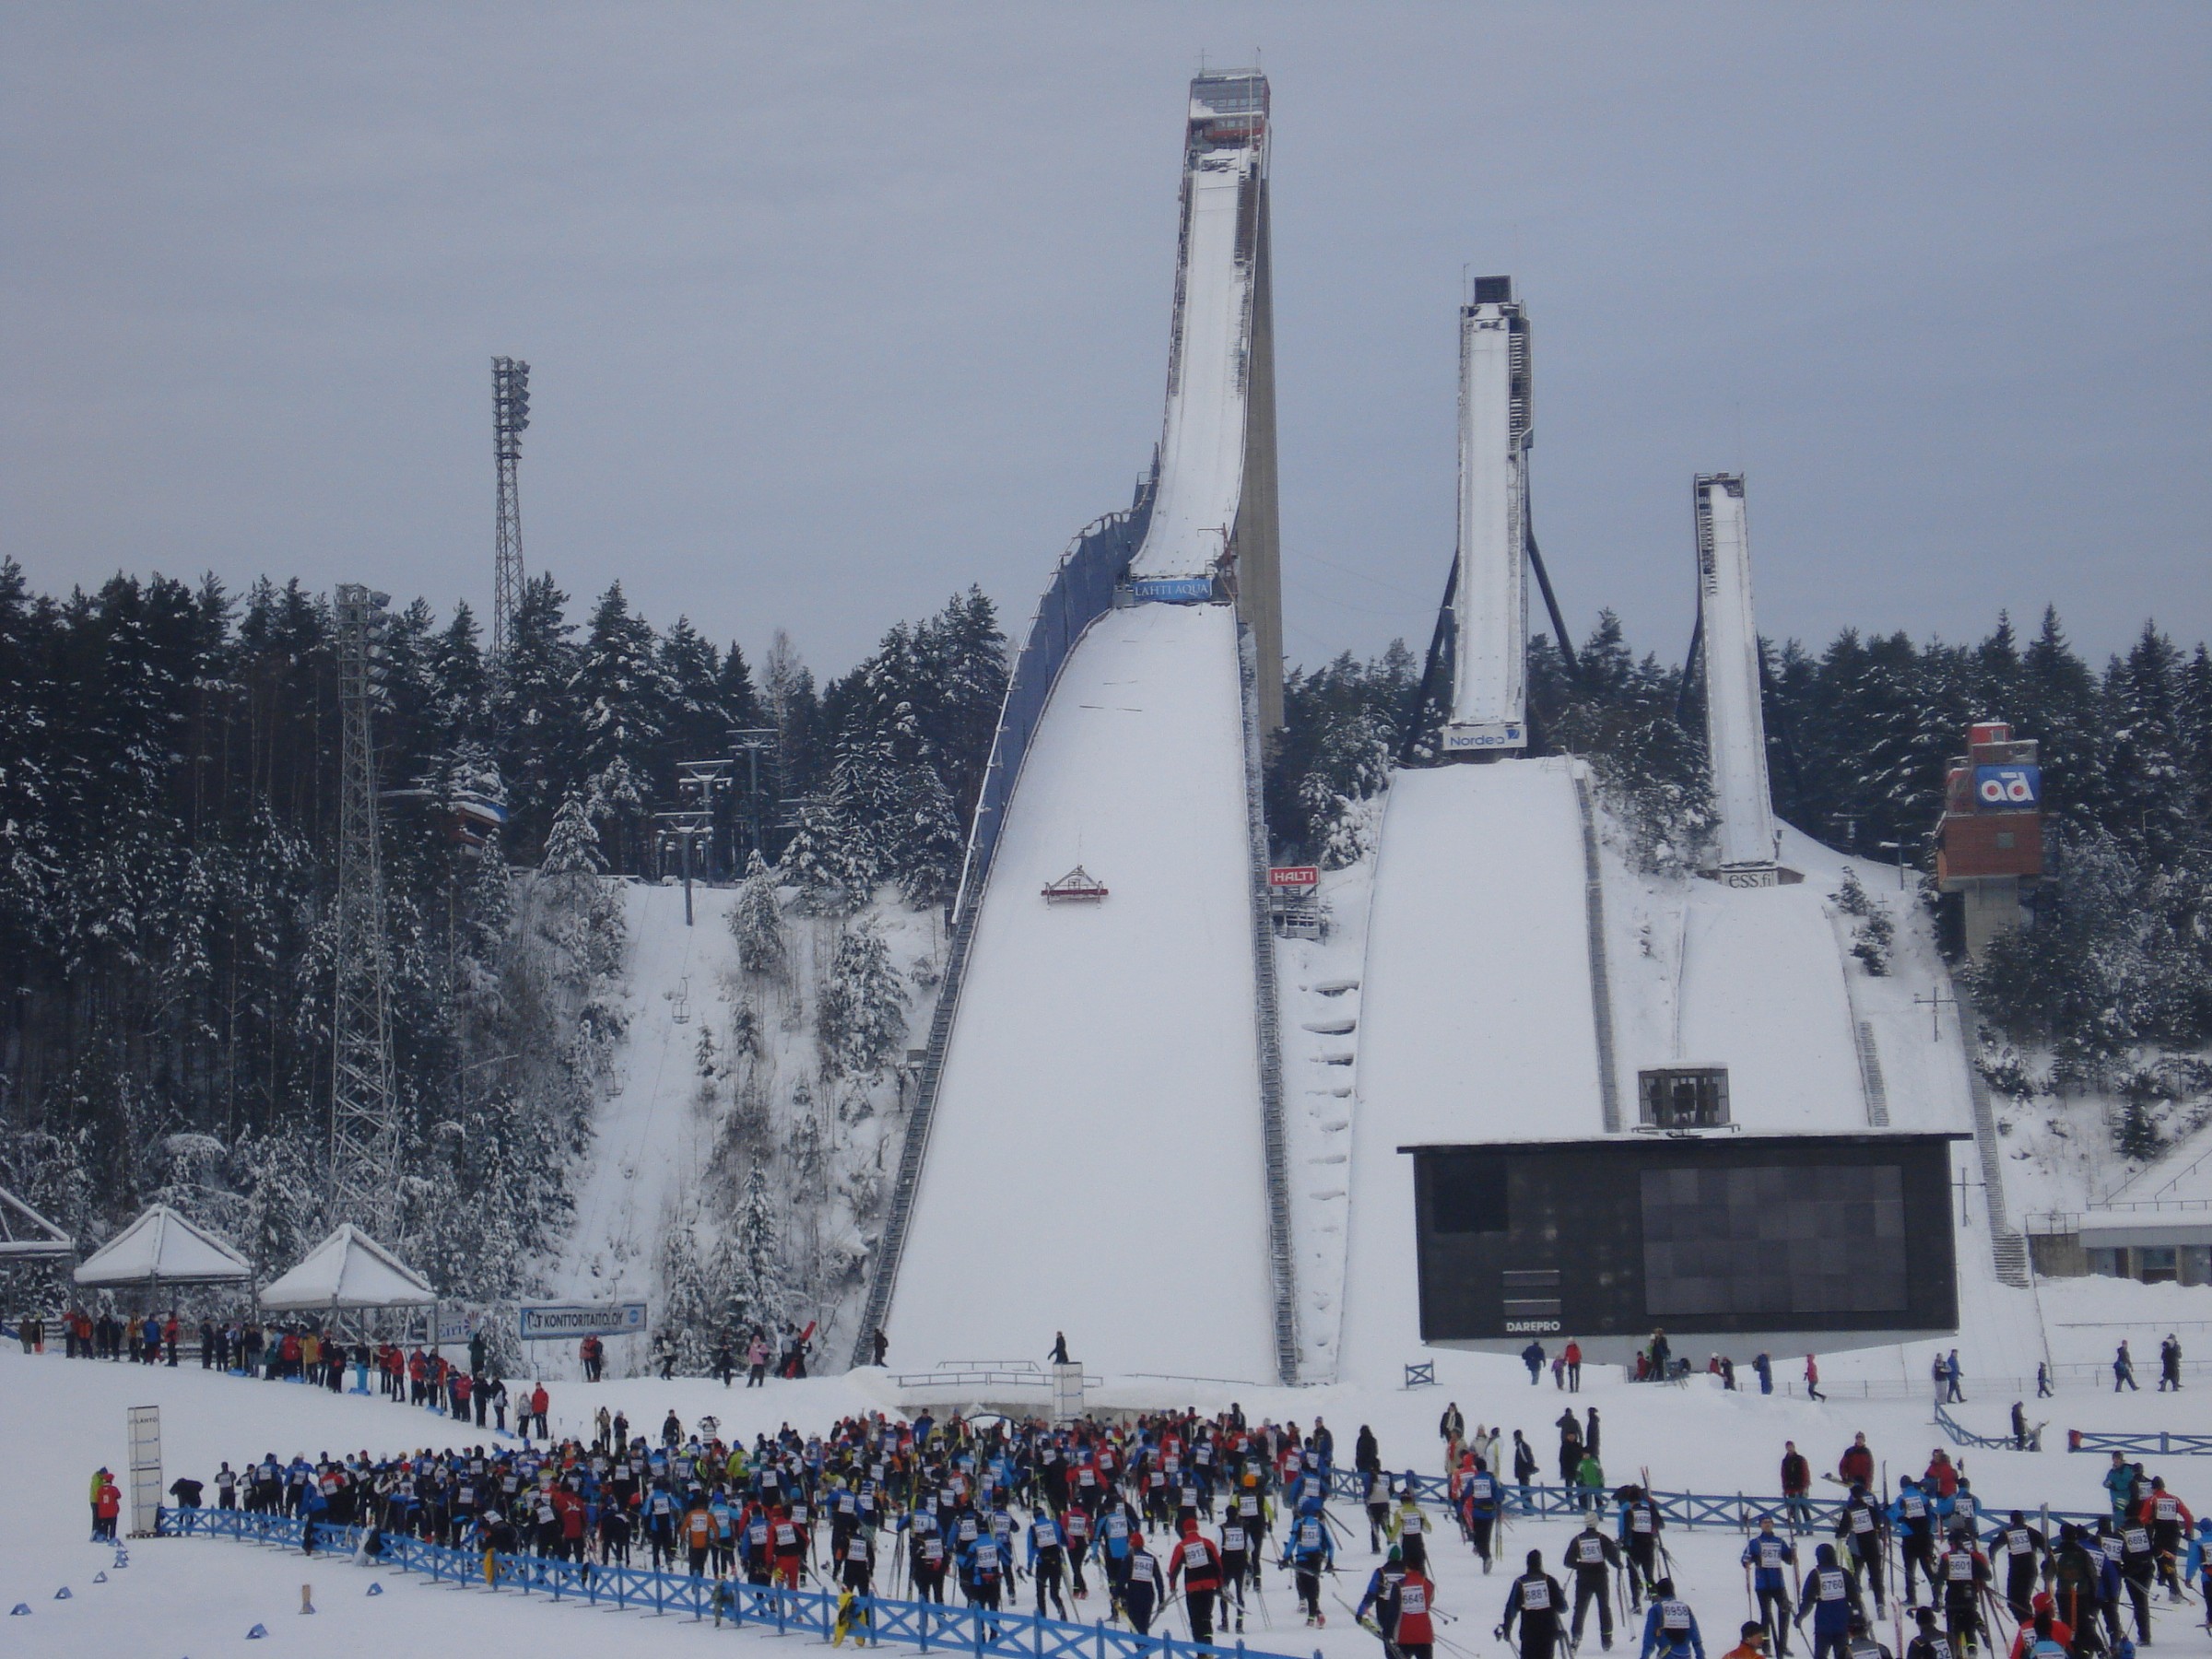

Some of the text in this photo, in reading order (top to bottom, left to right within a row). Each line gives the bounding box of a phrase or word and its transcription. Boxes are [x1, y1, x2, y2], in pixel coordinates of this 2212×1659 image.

[1135, 583, 1209, 597] LAHTI AQUA
[1450, 735, 1505, 747] Nordea
[1274, 871, 1314, 882] HALTI
[1728, 873, 1771, 888] ess.fi
[1506, 1322, 1560, 1332] DAREPRO
[1821, 1579, 1844, 1591] 6760
[1402, 1593, 1424, 1605] 6649
[1525, 1588, 1549, 1601] 6881
[1665, 1606, 1688, 1617] 6958
